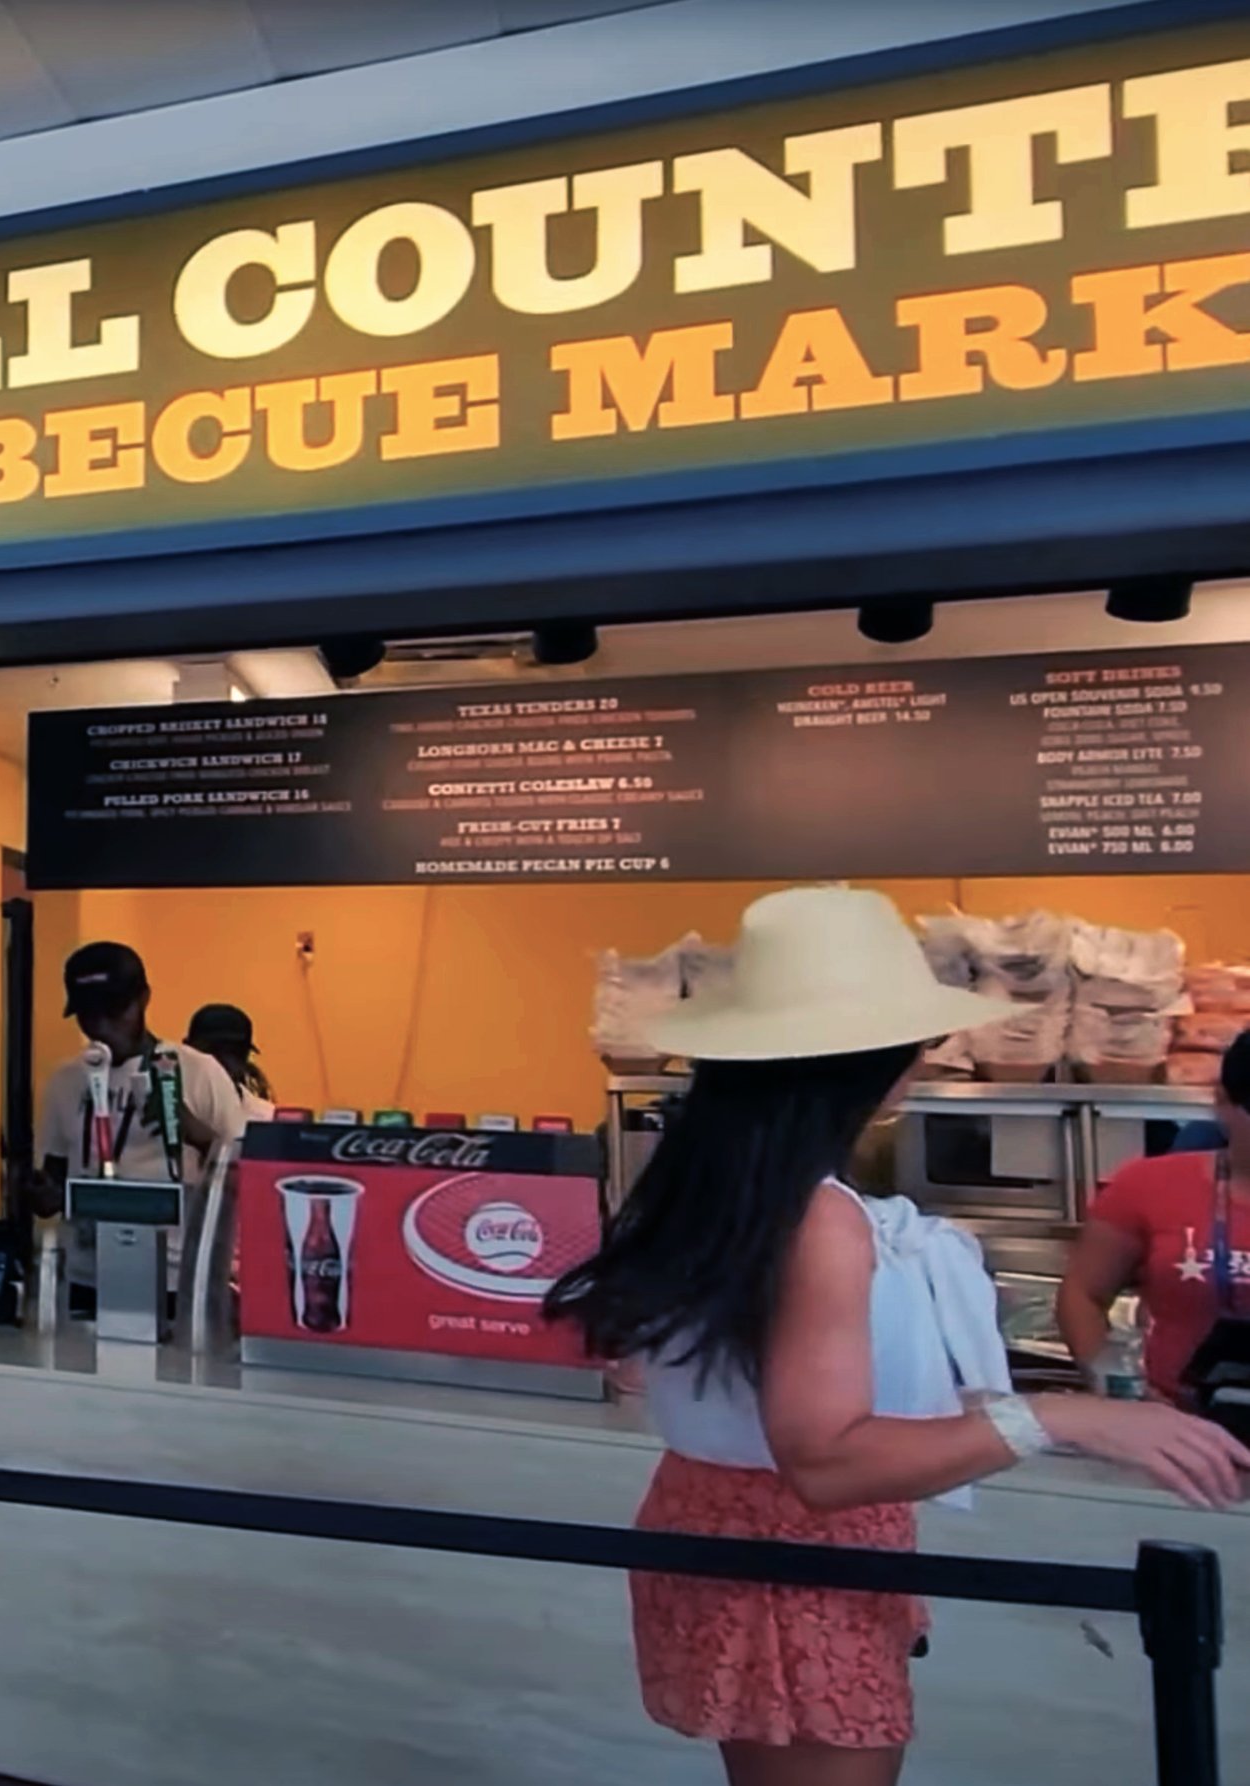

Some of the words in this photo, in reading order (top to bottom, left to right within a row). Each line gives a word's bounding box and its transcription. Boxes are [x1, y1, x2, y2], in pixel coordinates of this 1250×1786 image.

[552, 251, 1250, 441] MARK
[808, 684, 860, 696] COLD
[865, 681, 915, 694] BEER
[1031, 691, 1068, 704] OPEN
[457, 703, 512, 717] TEXAS
[515, 700, 595, 714] TENDERS
[87, 723, 156, 736] CHOPPED
[225, 714, 308, 728] SANDWICH
[856, 711, 887, 725] BEER
[418, 742, 514, 758] LONGHORN
[518, 740, 559, 754] MAC
[562, 739, 576, 751] &
[580, 736, 650, 750] CHEESE
[202, 753, 283, 766] SANDWICH
[428, 782, 515, 796] CONFETTI
[519, 777, 614, 792] COLESLAW
[104, 794, 159, 807] PULLED
[162, 792, 204, 804] PORK
[208, 789, 289, 802] SANDWICH
[1102, 794, 1135, 806] ICED
[1138, 793, 1165, 805] TEA
[458, 820, 552, 834] FRESH-CUT
[556, 818, 608, 831] FRIES
[415, 860, 519, 873] HOMEMADE
[522, 858, 581, 871] PECAN
[585, 858, 616, 871] PIE
[619, 857, 656, 870] CUP
[331, 1130, 496, 1167] Coca-Cola
[428, 1314, 475, 1330] great
[480, 1319, 530, 1336] serve
